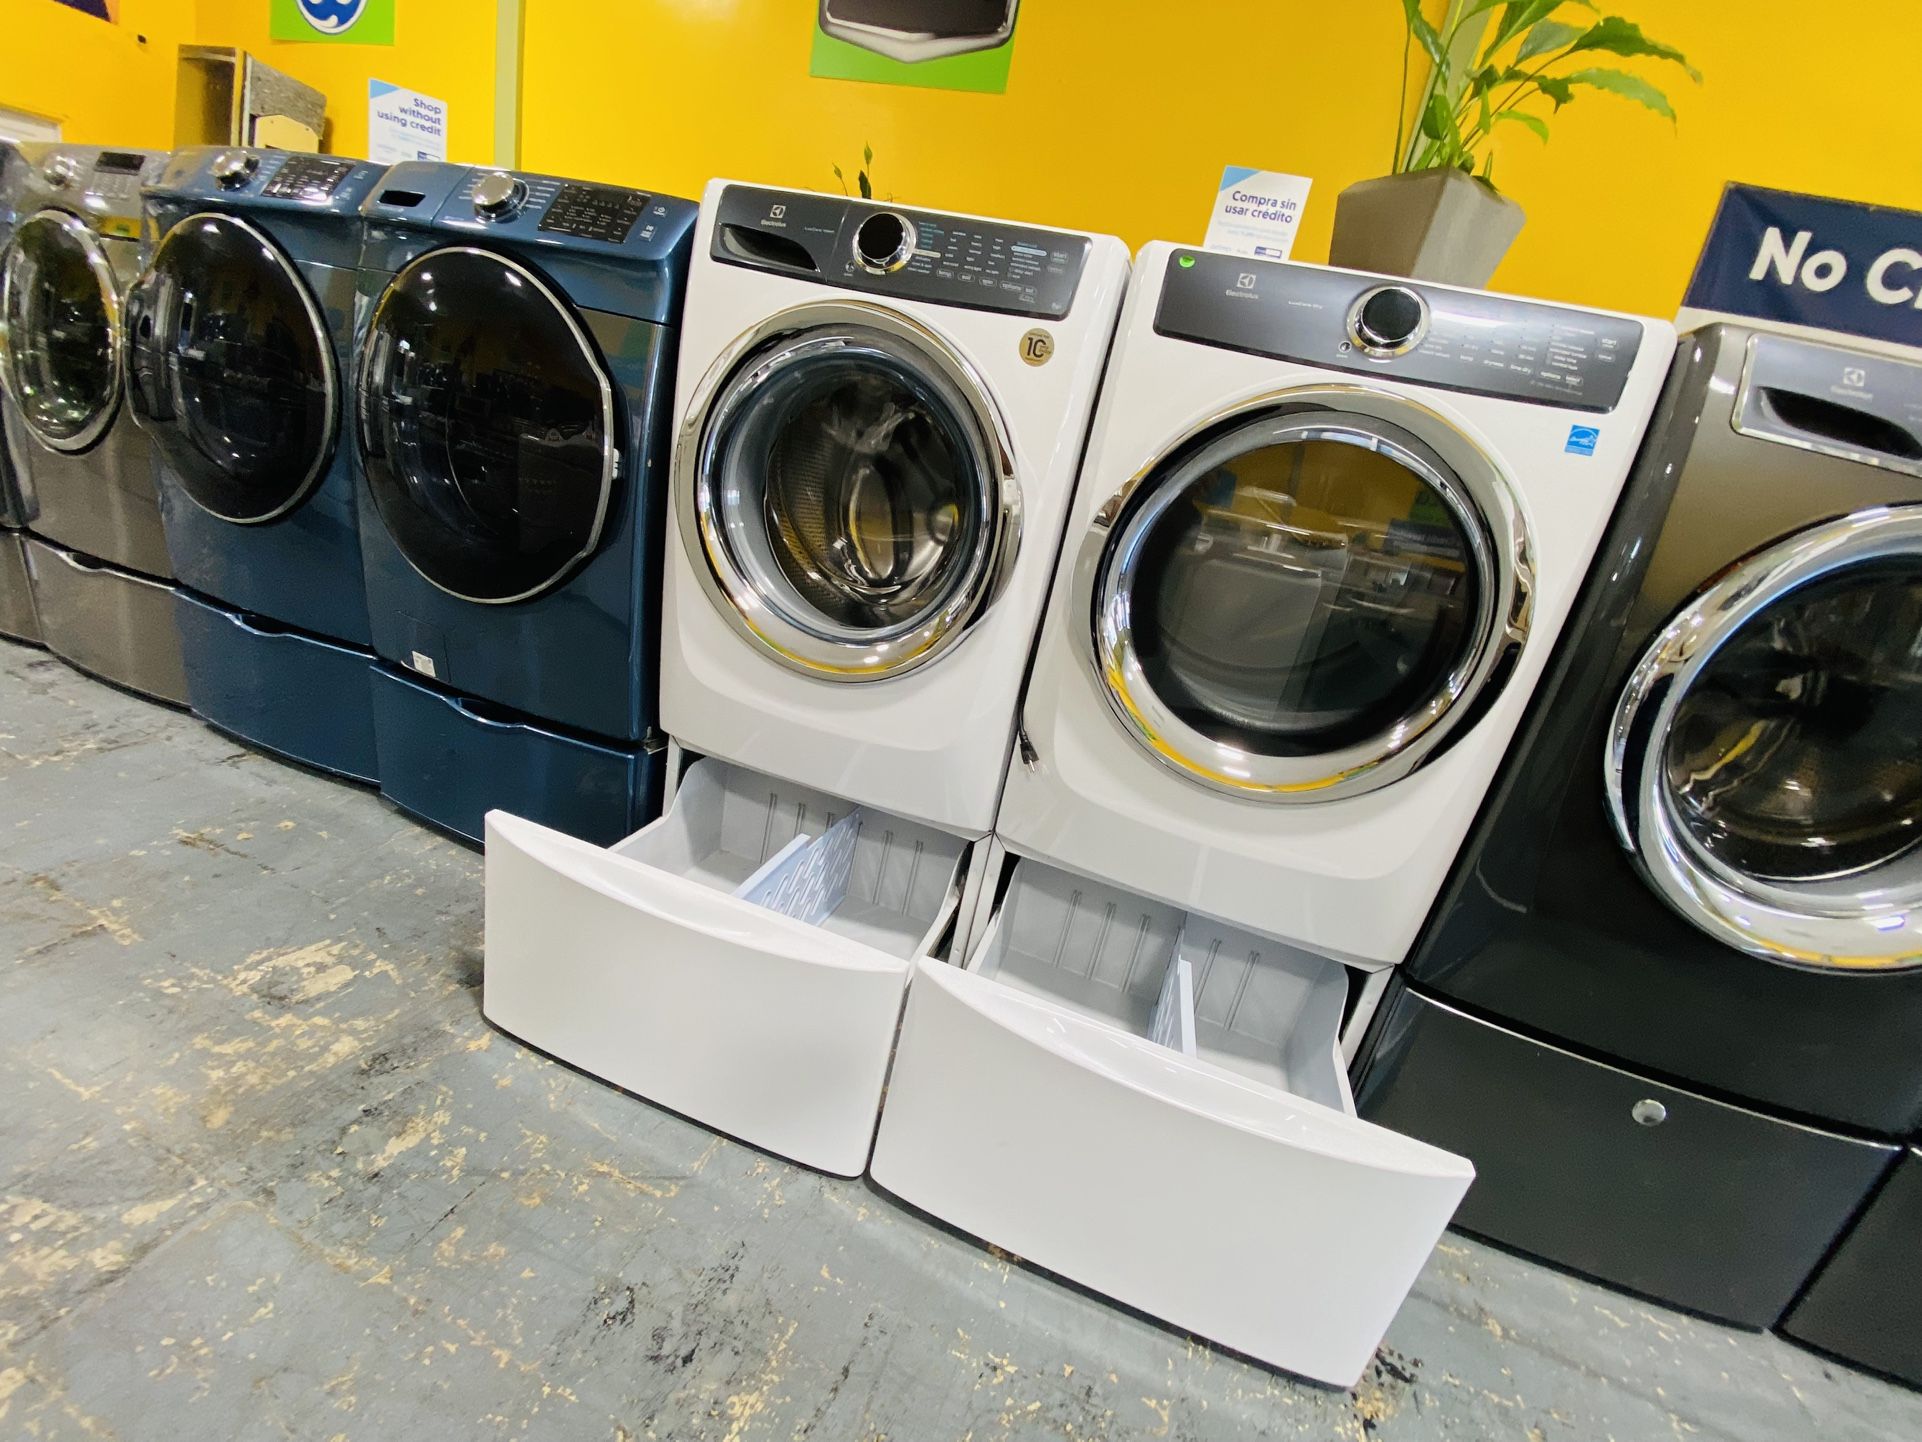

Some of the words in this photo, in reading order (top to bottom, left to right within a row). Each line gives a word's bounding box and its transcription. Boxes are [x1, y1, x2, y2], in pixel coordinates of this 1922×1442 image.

[399, 106, 441, 126] without
[413, 97, 442, 115] Shop
[377, 110, 408, 127] using
[410, 121, 441, 136] credit
[1232, 190, 1278, 208] Compra
[1280, 199, 1297, 211] sin
[1225, 204, 1250, 216] usar
[1251, 208, 1293, 223] crédito
[1749, 226, 1847, 292] No
[1866, 248, 1922, 309] C
